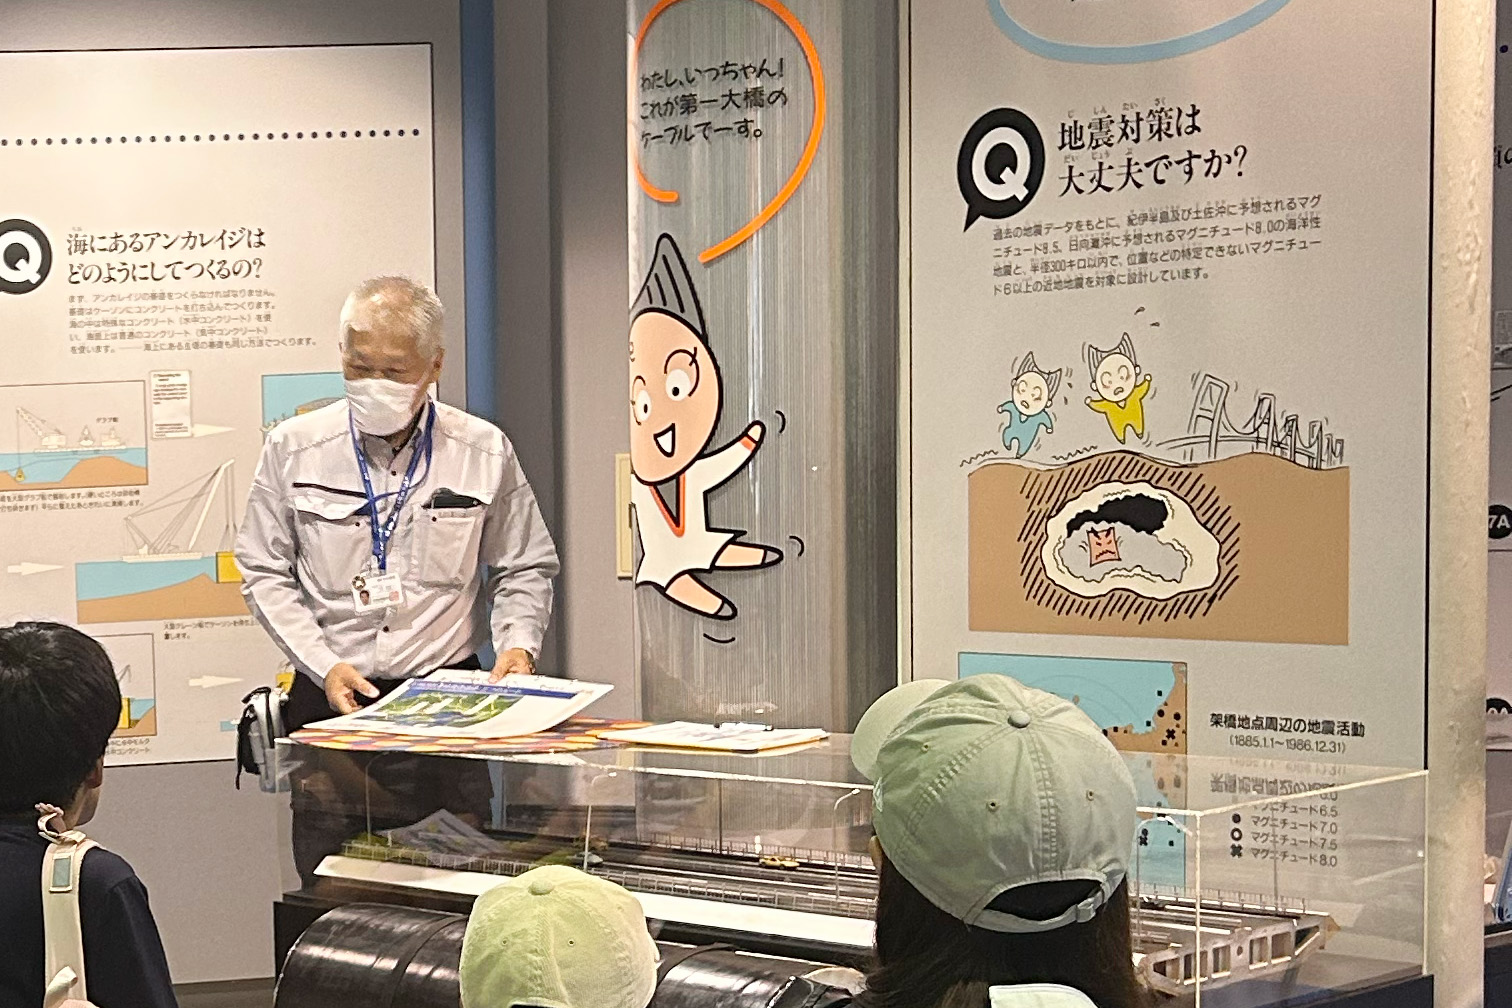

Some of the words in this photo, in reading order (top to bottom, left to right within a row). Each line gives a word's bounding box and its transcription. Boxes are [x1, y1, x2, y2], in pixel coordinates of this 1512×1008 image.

[641, 86, 788, 120] これが第一大橋の
[1057, 104, 1202, 151] 地震対策は
[972, 126, 1030, 203] Q
[1058, 144, 1248, 198] 大丈夫ですか?
[66, 227, 266, 256] 海にあるアンカレイジは
[67, 257, 264, 285] どのようにしてつくるの?
[1210, 712, 1366, 738] 架橋地点周辺の地震活動
[1251, 815, 1338, 834] マグニチュード7.0
[1251, 832, 1338, 850] マグニチュード7.5
[1251, 848, 1338, 868] マグニチュード8.0
